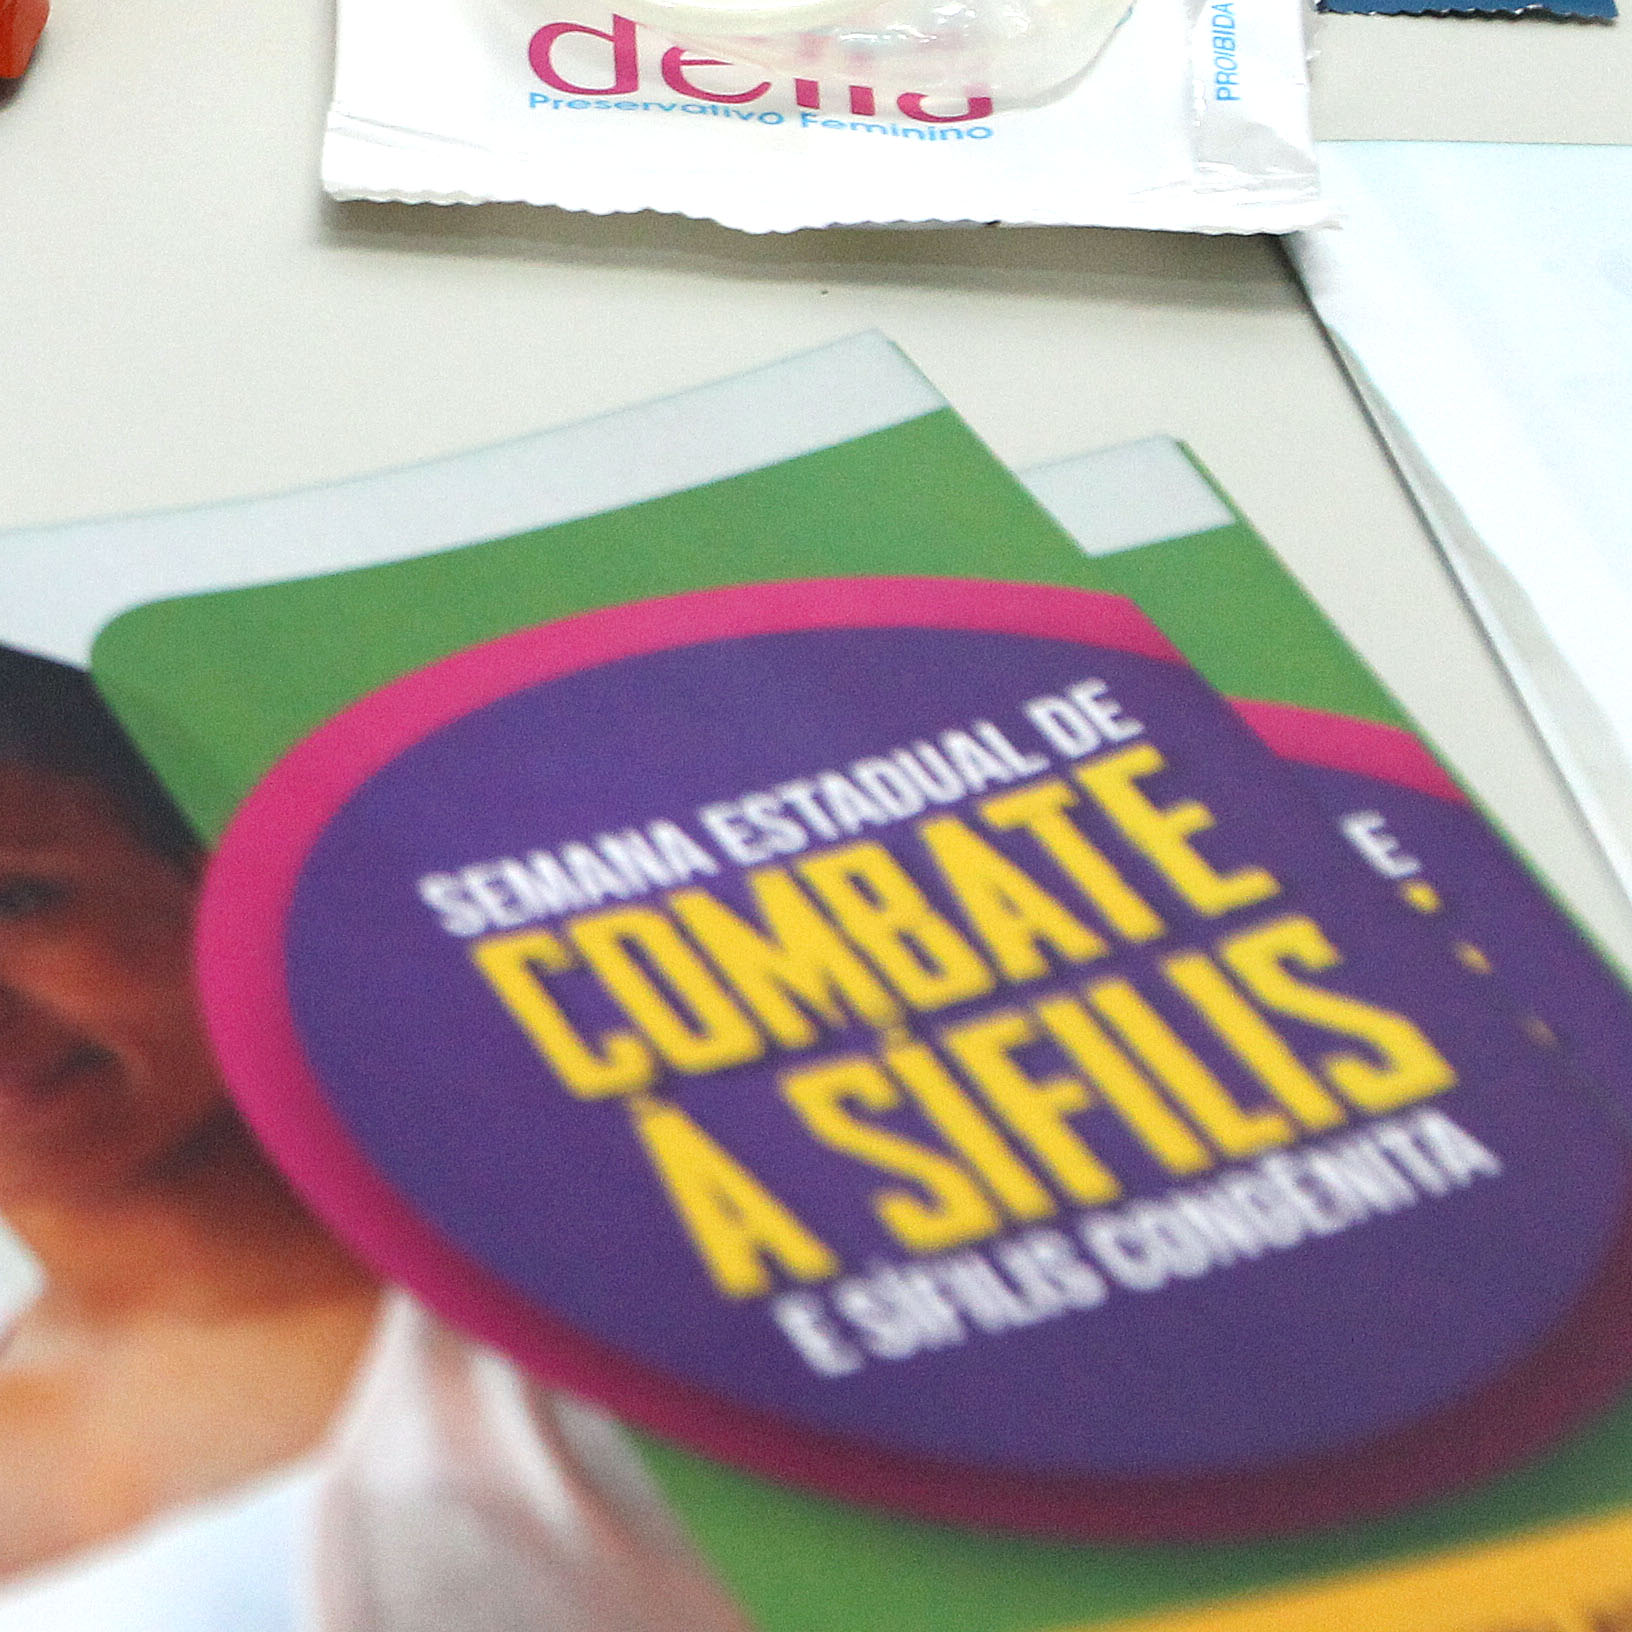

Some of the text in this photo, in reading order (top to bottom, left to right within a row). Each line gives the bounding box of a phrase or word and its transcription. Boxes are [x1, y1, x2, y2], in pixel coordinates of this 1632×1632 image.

[528, 91, 994, 142] Preservativo Feminino
[1210, 2, 1240, 101] PROIBIDA
[417, 677, 1146, 937] SEMANA ESTADUAL DE
[472, 742, 1281, 1101] COMBATE
[780, 912, 1458, 1251] SÍFILIS
